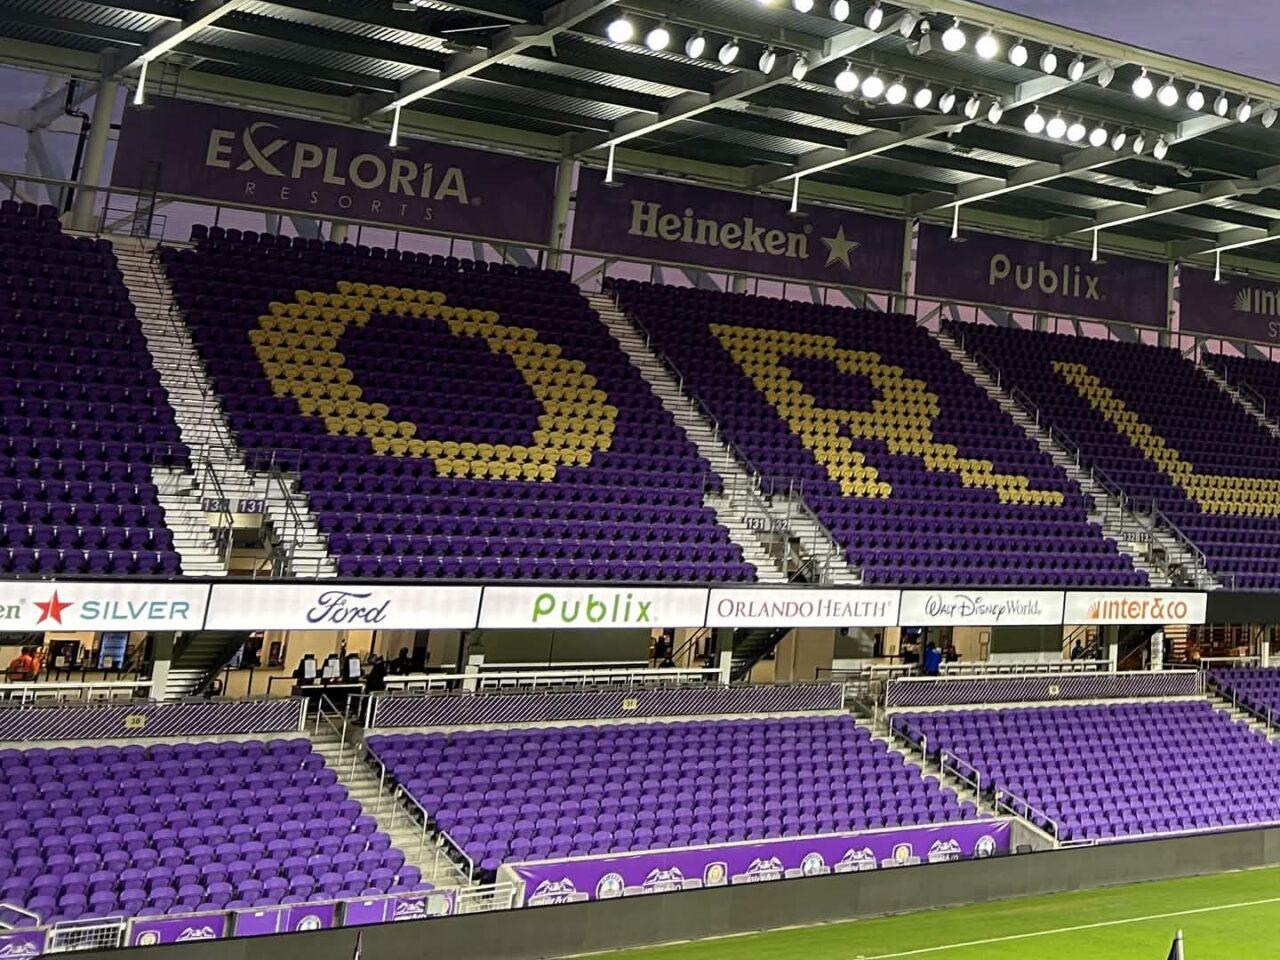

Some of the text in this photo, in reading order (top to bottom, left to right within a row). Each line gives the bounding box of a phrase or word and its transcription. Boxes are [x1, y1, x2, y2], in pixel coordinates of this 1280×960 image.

[245, 181, 433, 221] RESORTS
[627, 199, 810, 260] Heineken
[989, 253, 1101, 302] Publix
[240, 500, 264, 513] 131
[80, 600, 190, 620] SILVER
[306, 590, 392, 624] Ford
[532, 592, 652, 623] Publix
[717, 598, 886, 618] ORLANDO HEALTH
[1006, 599, 1038, 616] World
